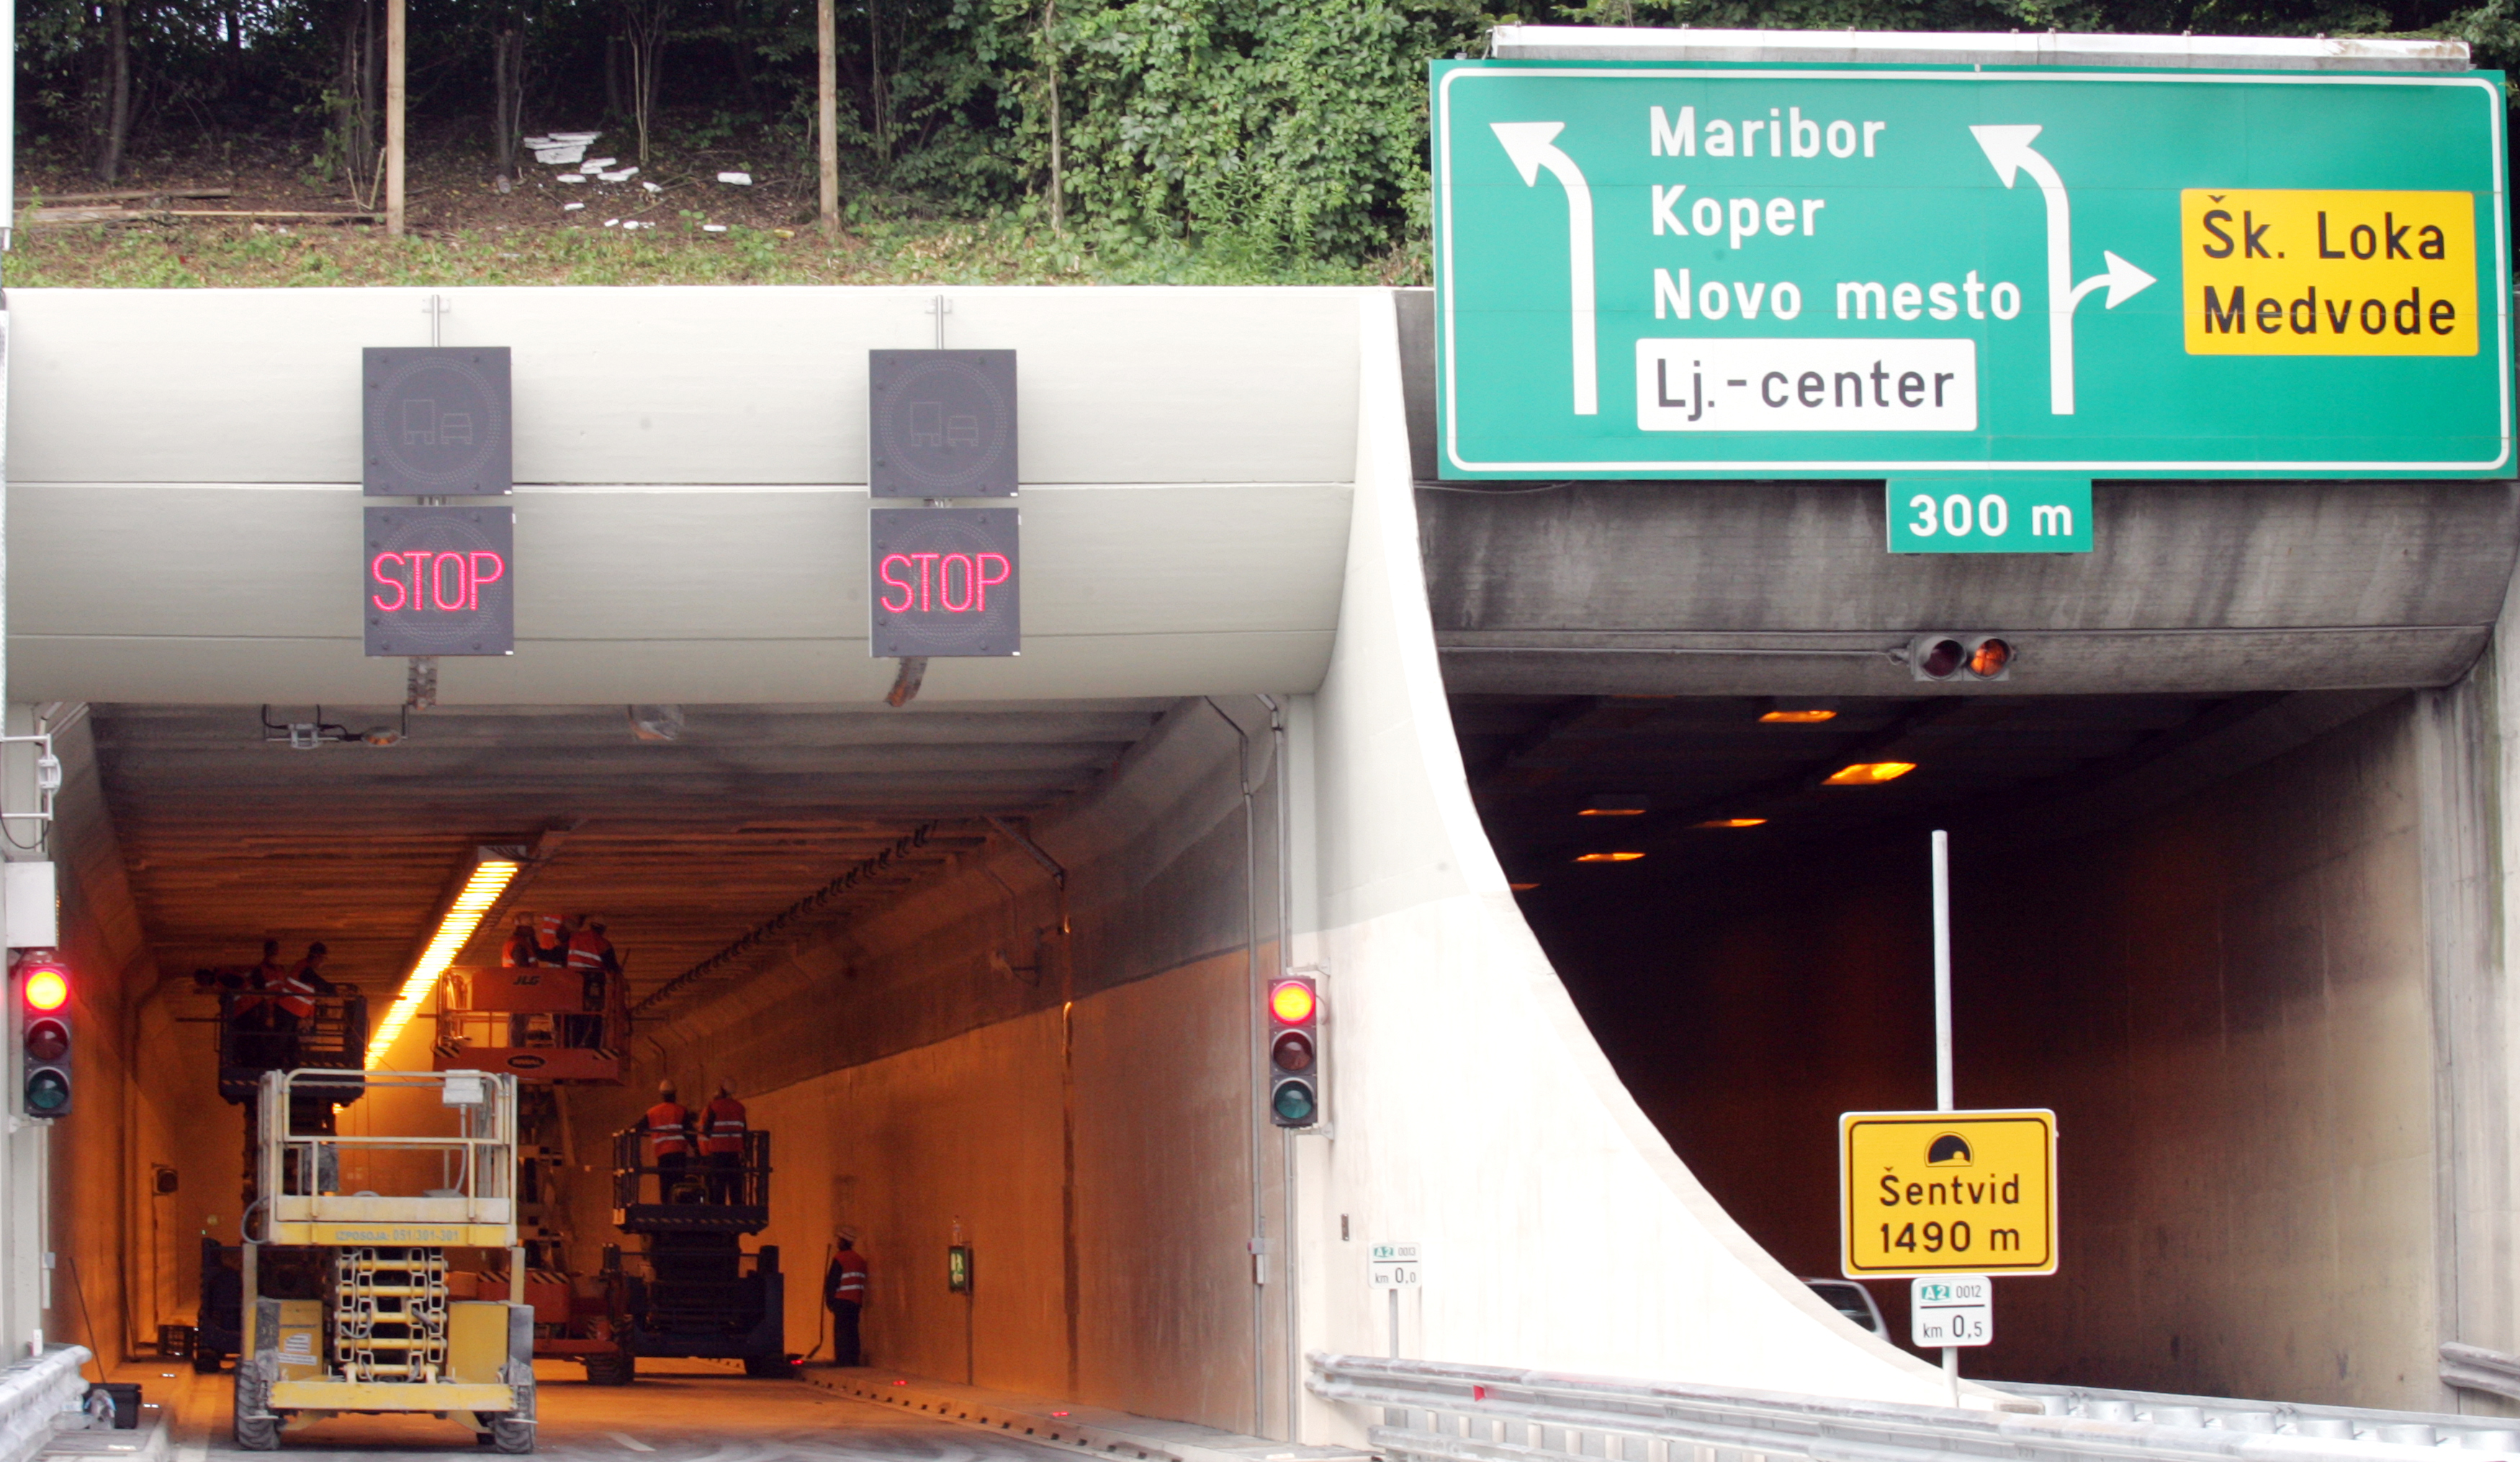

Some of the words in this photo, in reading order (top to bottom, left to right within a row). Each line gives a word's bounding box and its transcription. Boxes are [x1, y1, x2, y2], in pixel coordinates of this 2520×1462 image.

[1650, 105, 1886, 159] Maribor
[1650, 184, 1826, 250] Koper
[2202, 194, 2286, 260] Šk.
[2318, 211, 2446, 261] Loka
[1653, 267, 1803, 321] Novo
[1836, 269, 2022, 321] mesto
[2204, 285, 2457, 336] Medvode
[1656, 358, 1955, 422] Lj.-center
[1908, 494, 2008, 537] 300
[2032, 505, 2074, 536] m
[372, 550, 505, 612] STOP
[879, 552, 1012, 614] STOP
[513, 975, 540, 985] JLG
[1879, 1166, 2020, 1207] Šentvid
[1376, 1246, 1391, 1257] A2
[1398, 1247, 1416, 1256] 0013
[1880, 1220, 1971, 1253] 1490
[1990, 1228, 2020, 1252] m
[1374, 1273, 1389, 1283] km
[1924, 1285, 1947, 1299] A2
[1956, 1285, 1981, 1298] 0012
[1922, 1323, 1943, 1338] km
[1953, 1314, 1982, 1339] 0,5
